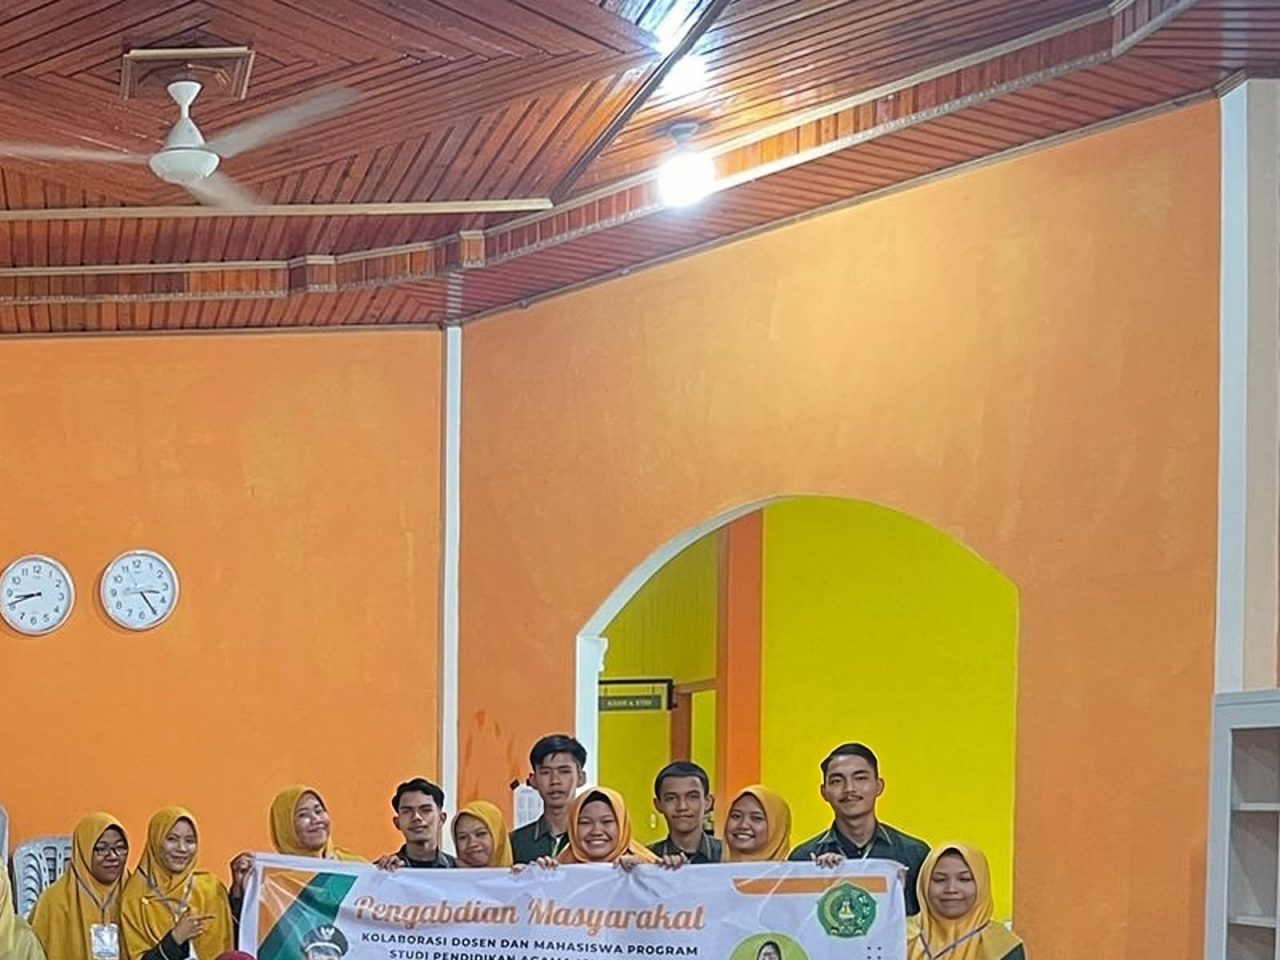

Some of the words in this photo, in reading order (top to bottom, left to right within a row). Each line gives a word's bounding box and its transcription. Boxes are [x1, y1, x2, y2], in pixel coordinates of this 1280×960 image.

[132, 560, 141, 568] 12
[149, 562, 153, 570] 1
[22, 568, 28, 576] 11
[33, 565, 41, 573] 12
[157, 570, 164, 579] 2
[12, 576, 21, 585] 10
[56, 579, 62, 588] 2
[114, 575, 123, 584] 10
[162, 582, 168, 591] 3
[6, 588, 13, 597] 9
[59, 592, 64, 601] 3
[111, 589, 117, 597] 9
[116, 601, 122, 609] 8
[20, 612, 25, 620] 7
[127, 609, 133, 617] 7
[139, 611, 145, 620] 6
[30, 616, 37, 625] 6
[43, 614, 50, 622] 5
[354, 895, 519, 930] Pengabdian
[361, 932, 448, 946] KOLABORASI
[451, 937, 497, 948] DOSEN
[500, 939, 529, 949] DAN
[533, 940, 623, 954] MAHASISWA
[627, 945, 698, 956] PROGRAM
[389, 949, 429, 960] STUDI
